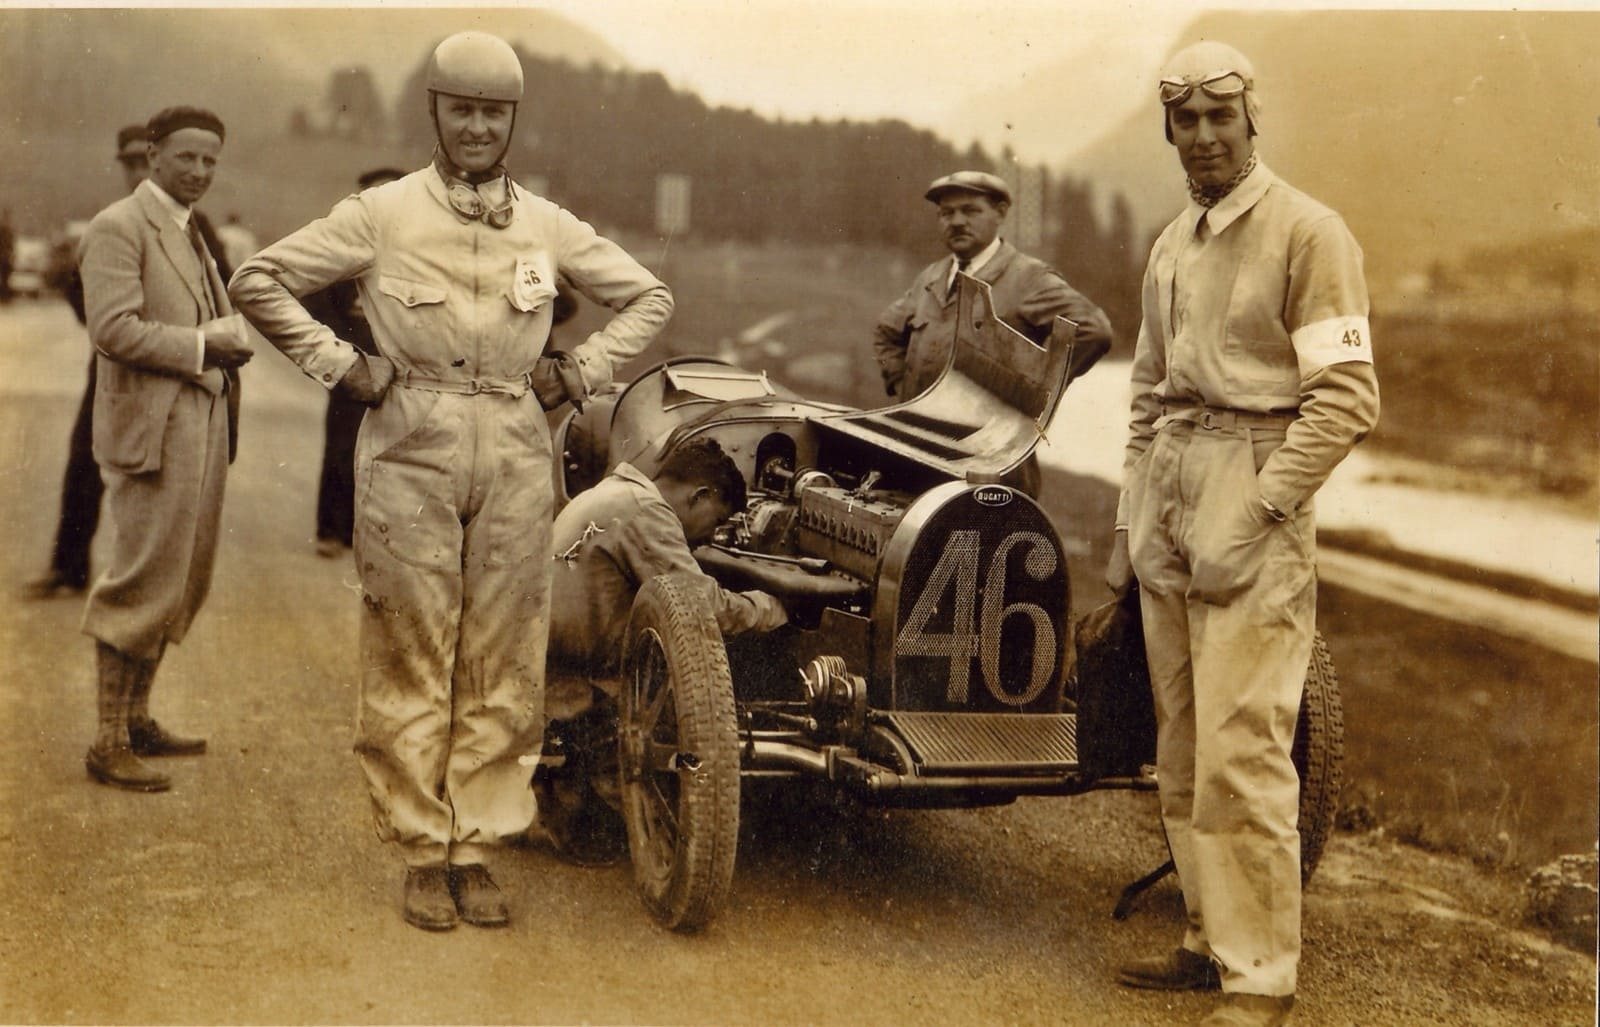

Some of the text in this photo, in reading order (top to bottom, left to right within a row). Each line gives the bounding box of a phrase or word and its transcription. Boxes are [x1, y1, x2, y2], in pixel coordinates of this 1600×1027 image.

[1342, 329, 1361, 347] 43
[978, 492, 1009, 501] BUGATTI
[895, 529, 1058, 705] 46
